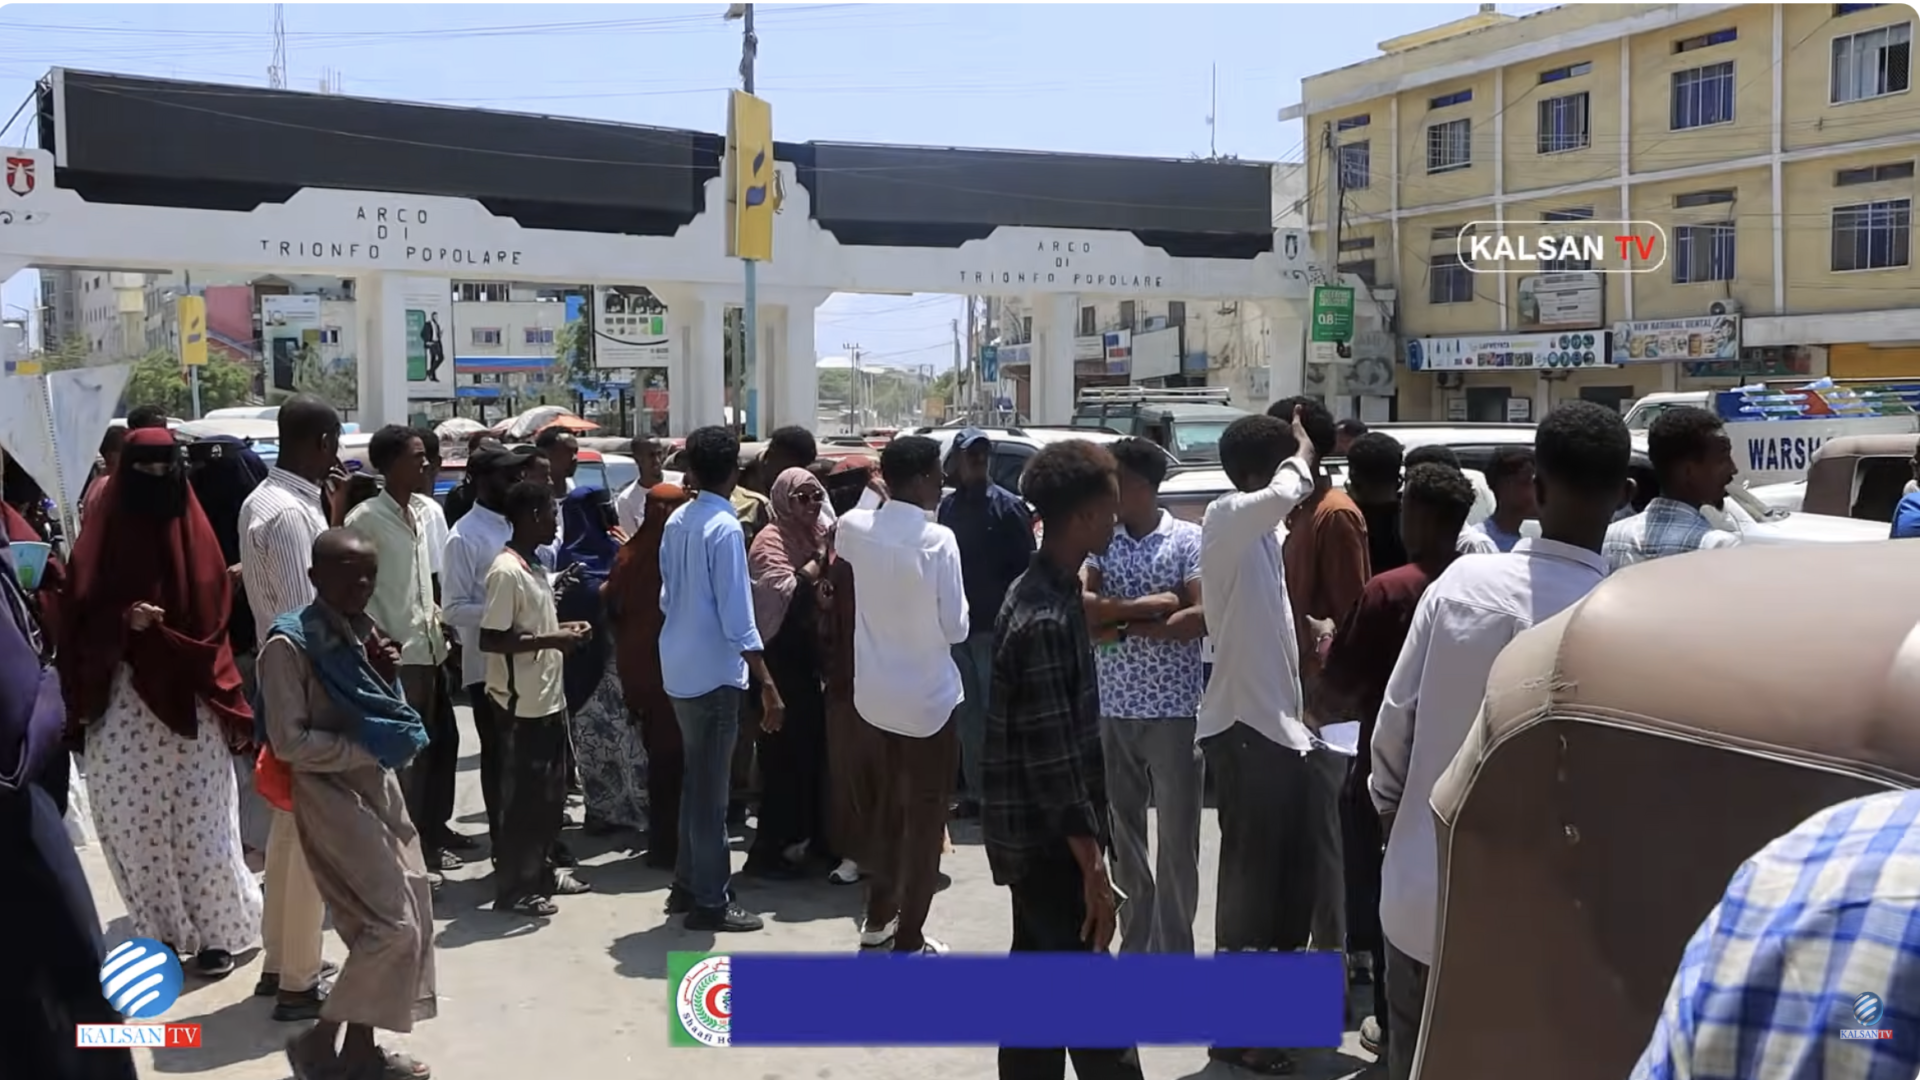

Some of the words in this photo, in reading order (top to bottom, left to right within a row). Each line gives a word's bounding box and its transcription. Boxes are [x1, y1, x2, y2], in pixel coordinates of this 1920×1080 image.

[356, 206, 428, 224] ARCO
[377, 225, 408, 240] DI
[260, 240, 380, 260] TRIONFO
[406, 246, 522, 265] POPOLARE
[1037, 241, 1091, 253] ARCO
[1055, 257, 1069, 268] DI
[960, 271, 1055, 283] TRIONFO
[1073, 273, 1163, 287] POPOLARE
[1633, 323, 1649, 331] NEW
[1651, 320, 1683, 330] NATIONAL
[1685, 318, 1712, 329] DENTAL
[1748, 437, 1834, 470] WARSH
